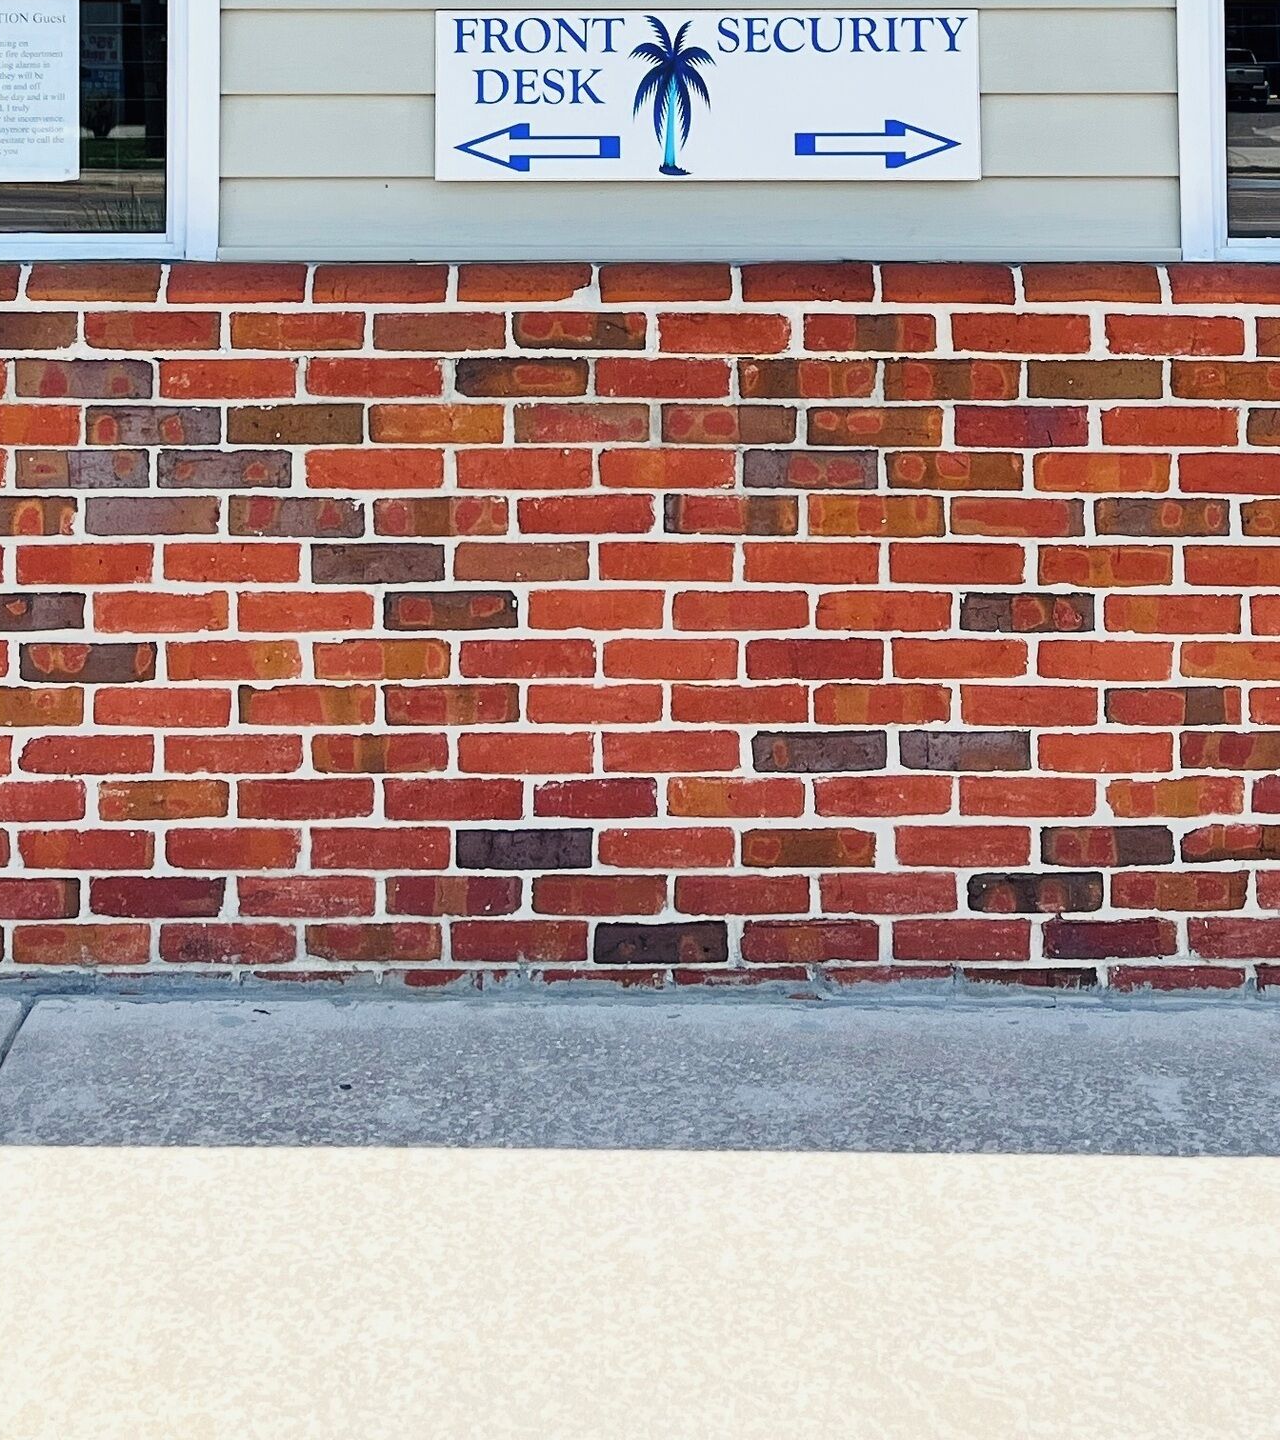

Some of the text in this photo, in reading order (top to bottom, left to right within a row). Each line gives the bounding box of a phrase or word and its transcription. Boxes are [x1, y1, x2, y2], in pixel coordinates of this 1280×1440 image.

[33, 12, 67, 24] Guest
[452, 17, 625, 54] FRONT
[717, 16, 967, 53] SECURITY
[473, 68, 605, 105] DESK
